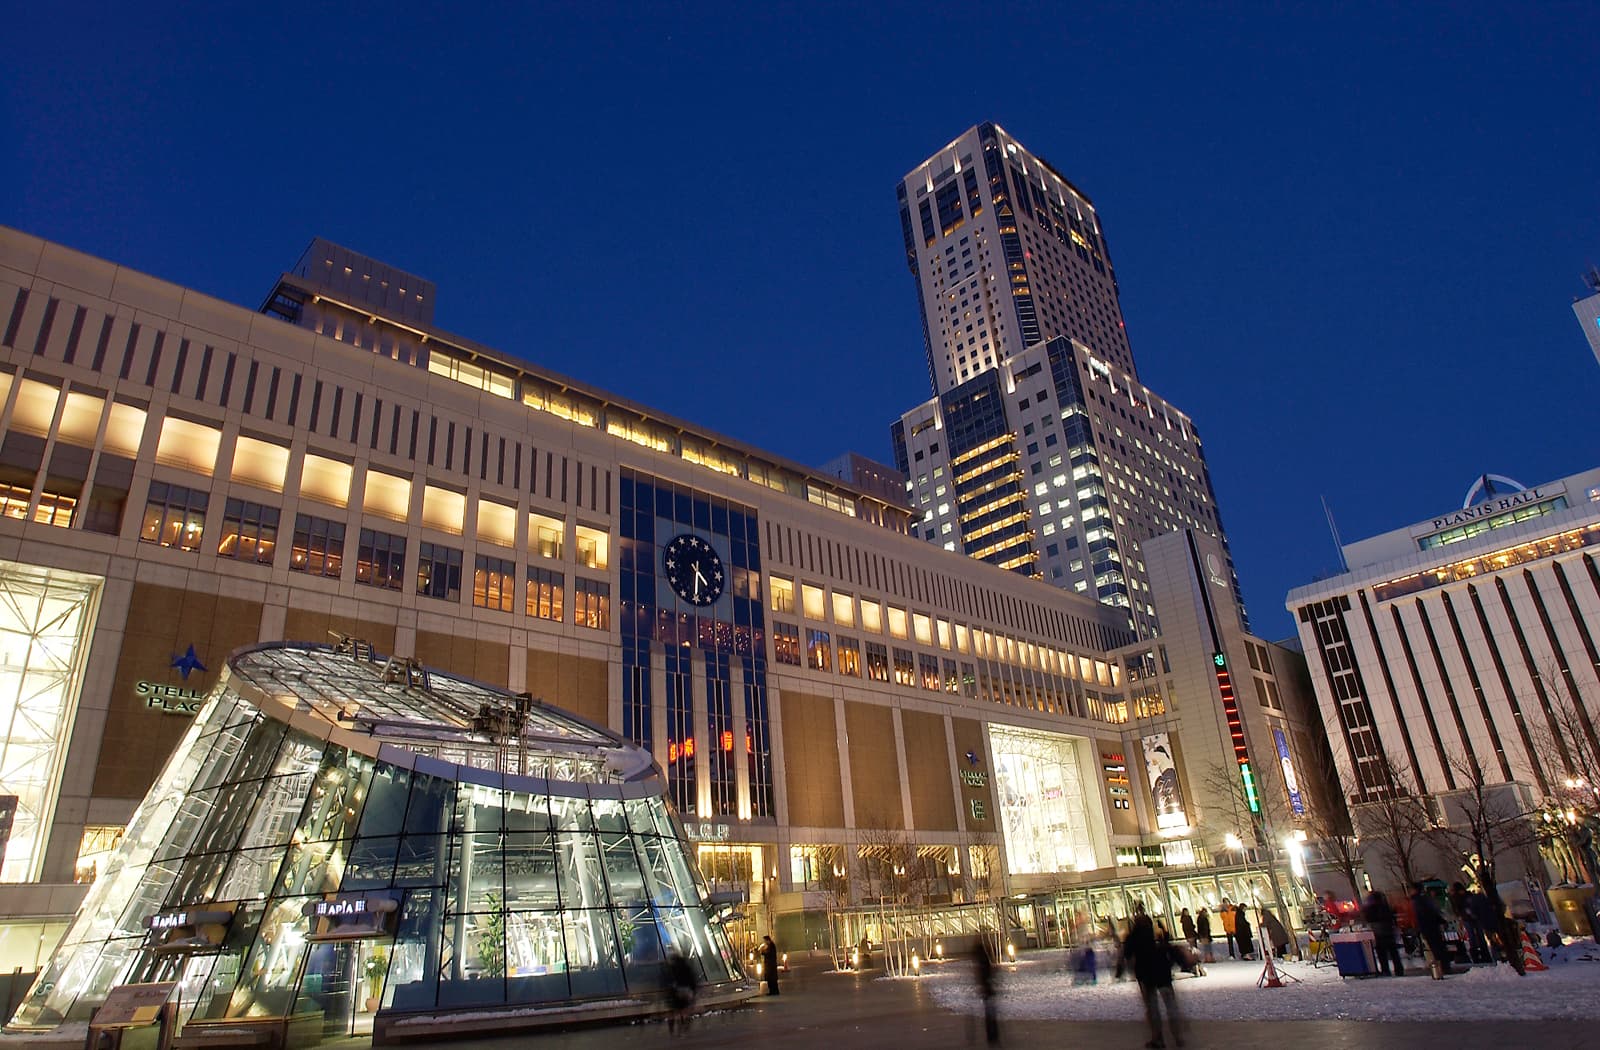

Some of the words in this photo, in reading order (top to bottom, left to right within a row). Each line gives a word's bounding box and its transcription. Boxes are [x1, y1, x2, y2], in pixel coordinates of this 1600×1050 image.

[1433, 503, 1492, 529] PLANIS
[1499, 488, 1544, 510] HALL
[136, 681, 208, 700] STELL
